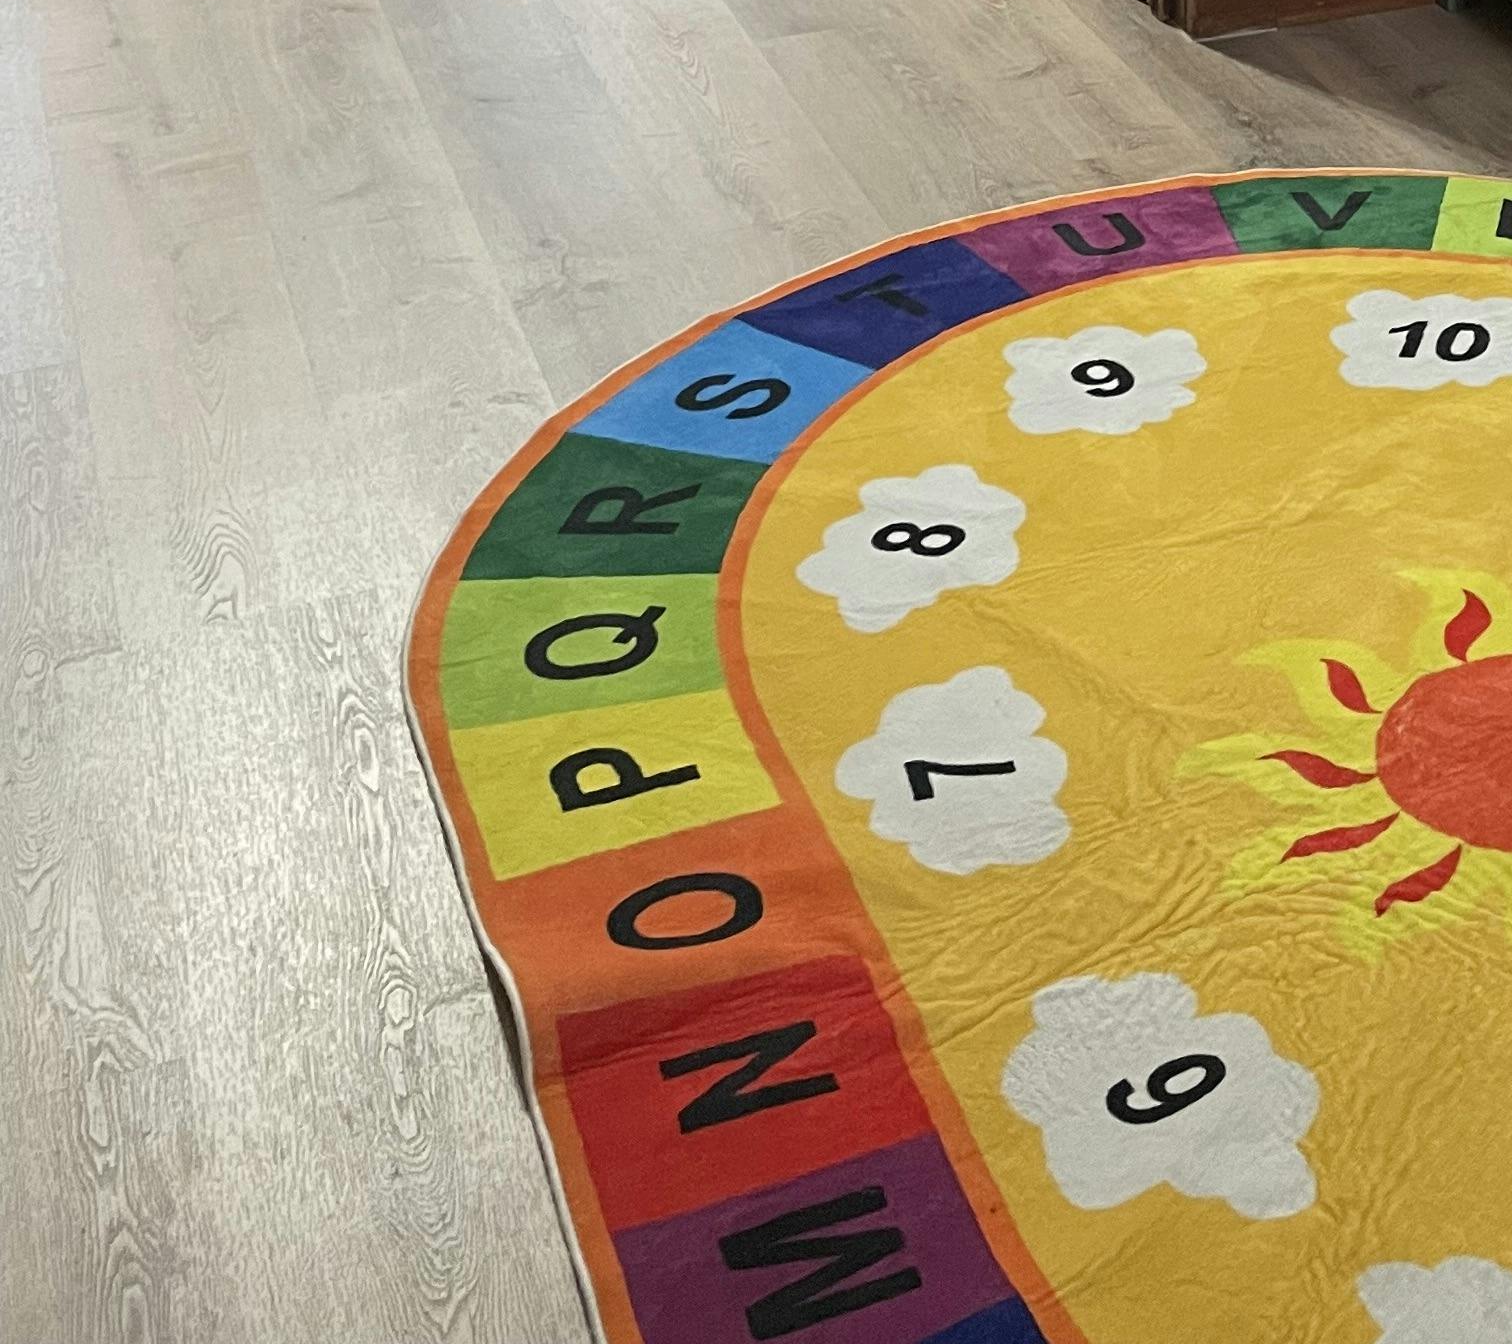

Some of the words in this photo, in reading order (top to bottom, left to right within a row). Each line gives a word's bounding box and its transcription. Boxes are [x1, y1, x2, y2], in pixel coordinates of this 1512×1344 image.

[1050, 212, 1146, 257] U
[1285, 189, 1374, 233] V
[834, 271, 932, 318] T
[1388, 320, 1491, 362] 10
[675, 373, 791, 420] S
[1070, 359, 1135, 398] 9
[558, 480, 703, 537] R
[870, 522, 966, 557] 8
[524, 605, 667, 681] Q
[549, 746, 701, 813] P
[903, 759, 1016, 801] 7
[606, 871, 764, 950] O
[658, 1019, 840, 1135] N
[1105, 1053, 1227, 1125] 6
[718, 1184, 923, 1341] M
